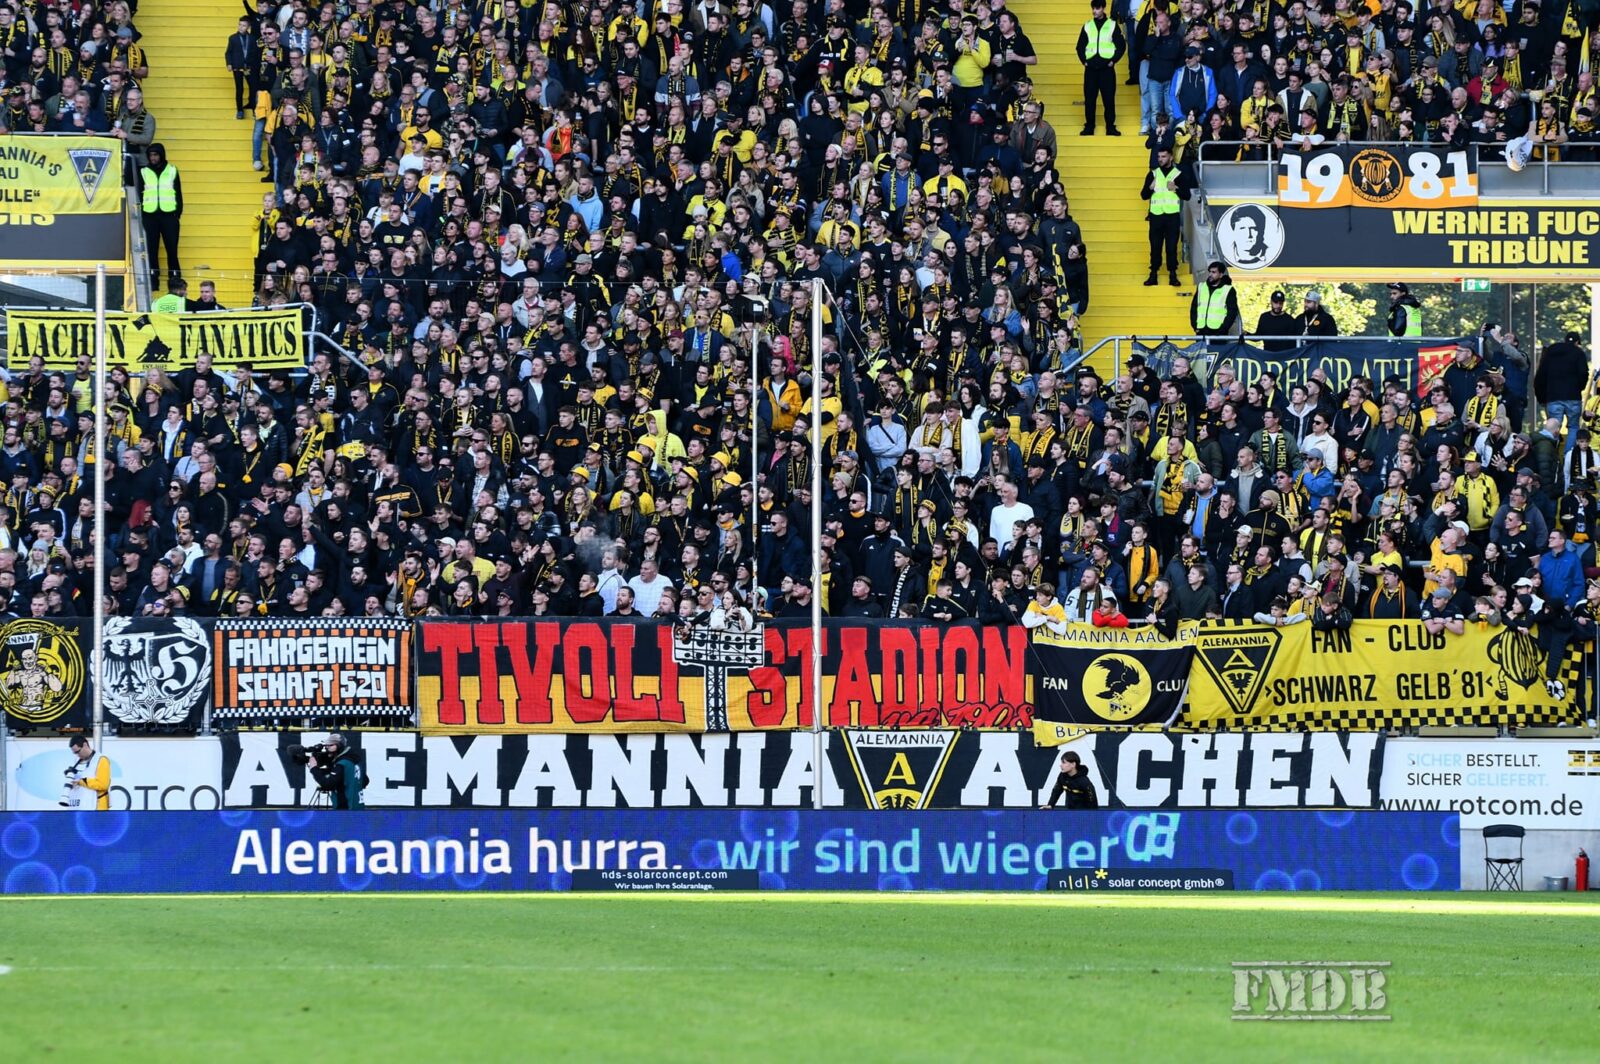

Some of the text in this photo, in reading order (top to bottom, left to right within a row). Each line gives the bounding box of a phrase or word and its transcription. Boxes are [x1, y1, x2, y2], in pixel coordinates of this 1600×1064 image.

[1279, 151, 1478, 203] 19 81
[1392, 210, 1600, 235] WERNER FUC
[1448, 236, 1589, 264] TRIBÜNE
[179, 321, 298, 359] FANATICS
[1135, 625, 1198, 643] AACEN
[1202, 635, 1270, 647] ALEMANNIA
[1311, 626, 1352, 653] FAN
[1388, 624, 1446, 652] CLUB
[238, 670, 388, 700] SCHAFT 520
[423, 622, 1029, 728] TIVOLI STADION
[1042, 677, 1068, 690] FAN
[855, 733, 946, 746] ALEMANNIA
[883, 752, 916, 785] A
[961, 731, 1378, 807] AACHEN
[1407, 753, 1541, 767] SICHER BESTELLT.
[1407, 773, 1549, 787] SICHER GELIEFERT.
[1379, 793, 1584, 816] wwrotcom.de
[231, 828, 511, 875] Alemannia
[716, 828, 800, 873] wir
[815, 828, 920, 874] sind
[938, 831, 1119, 875] wieder
[601, 870, 728, 880] nds-solarconcept.com
[615, 882, 630, 890] Wir
[632, 882, 654, 890] bauen
[655, 882, 670, 890] Ihre
[1108, 877, 1135, 888] solar
[1138, 878, 1182, 890] concept
